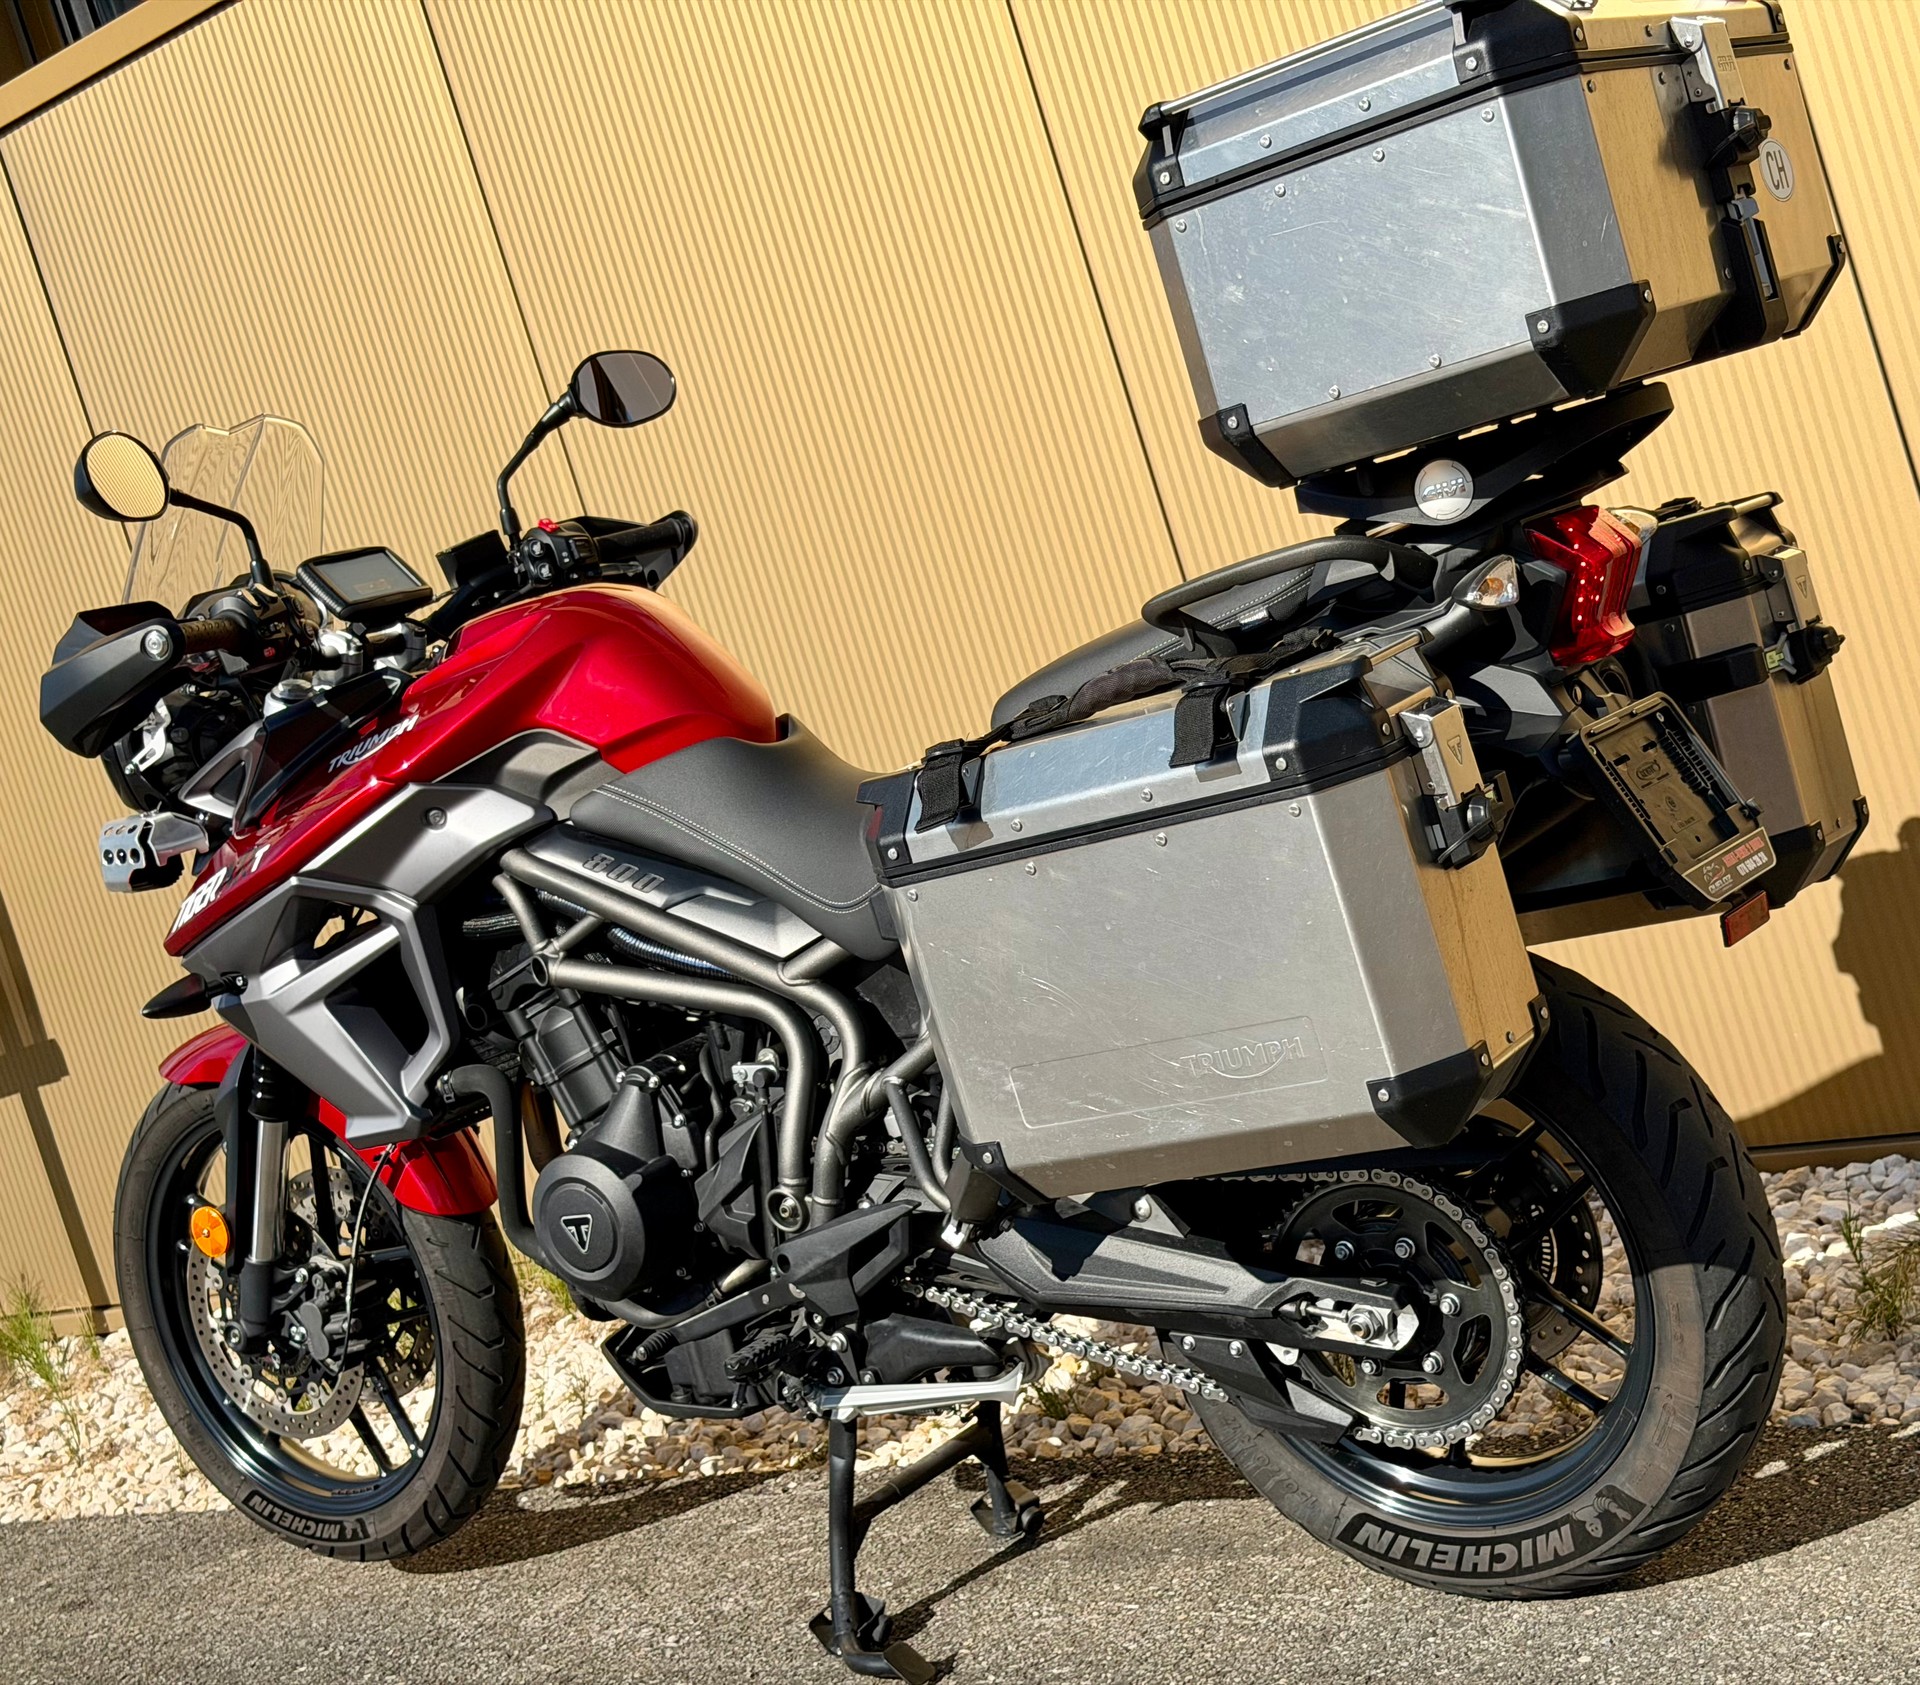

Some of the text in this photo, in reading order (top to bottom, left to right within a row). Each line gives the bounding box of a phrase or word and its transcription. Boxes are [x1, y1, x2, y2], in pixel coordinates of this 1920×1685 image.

[1765, 150, 1790, 191] CH
[1422, 477, 1467, 502] GIVI
[328, 714, 419, 774] TRIUMPH
[582, 852, 665, 894] 800
[171, 866, 228, 934] TIGER
[1179, 1036, 1307, 1079] TRIUMPH
[248, 1495, 341, 1540] MICHELIN
[1352, 1521, 1576, 1573] MICHELIN
